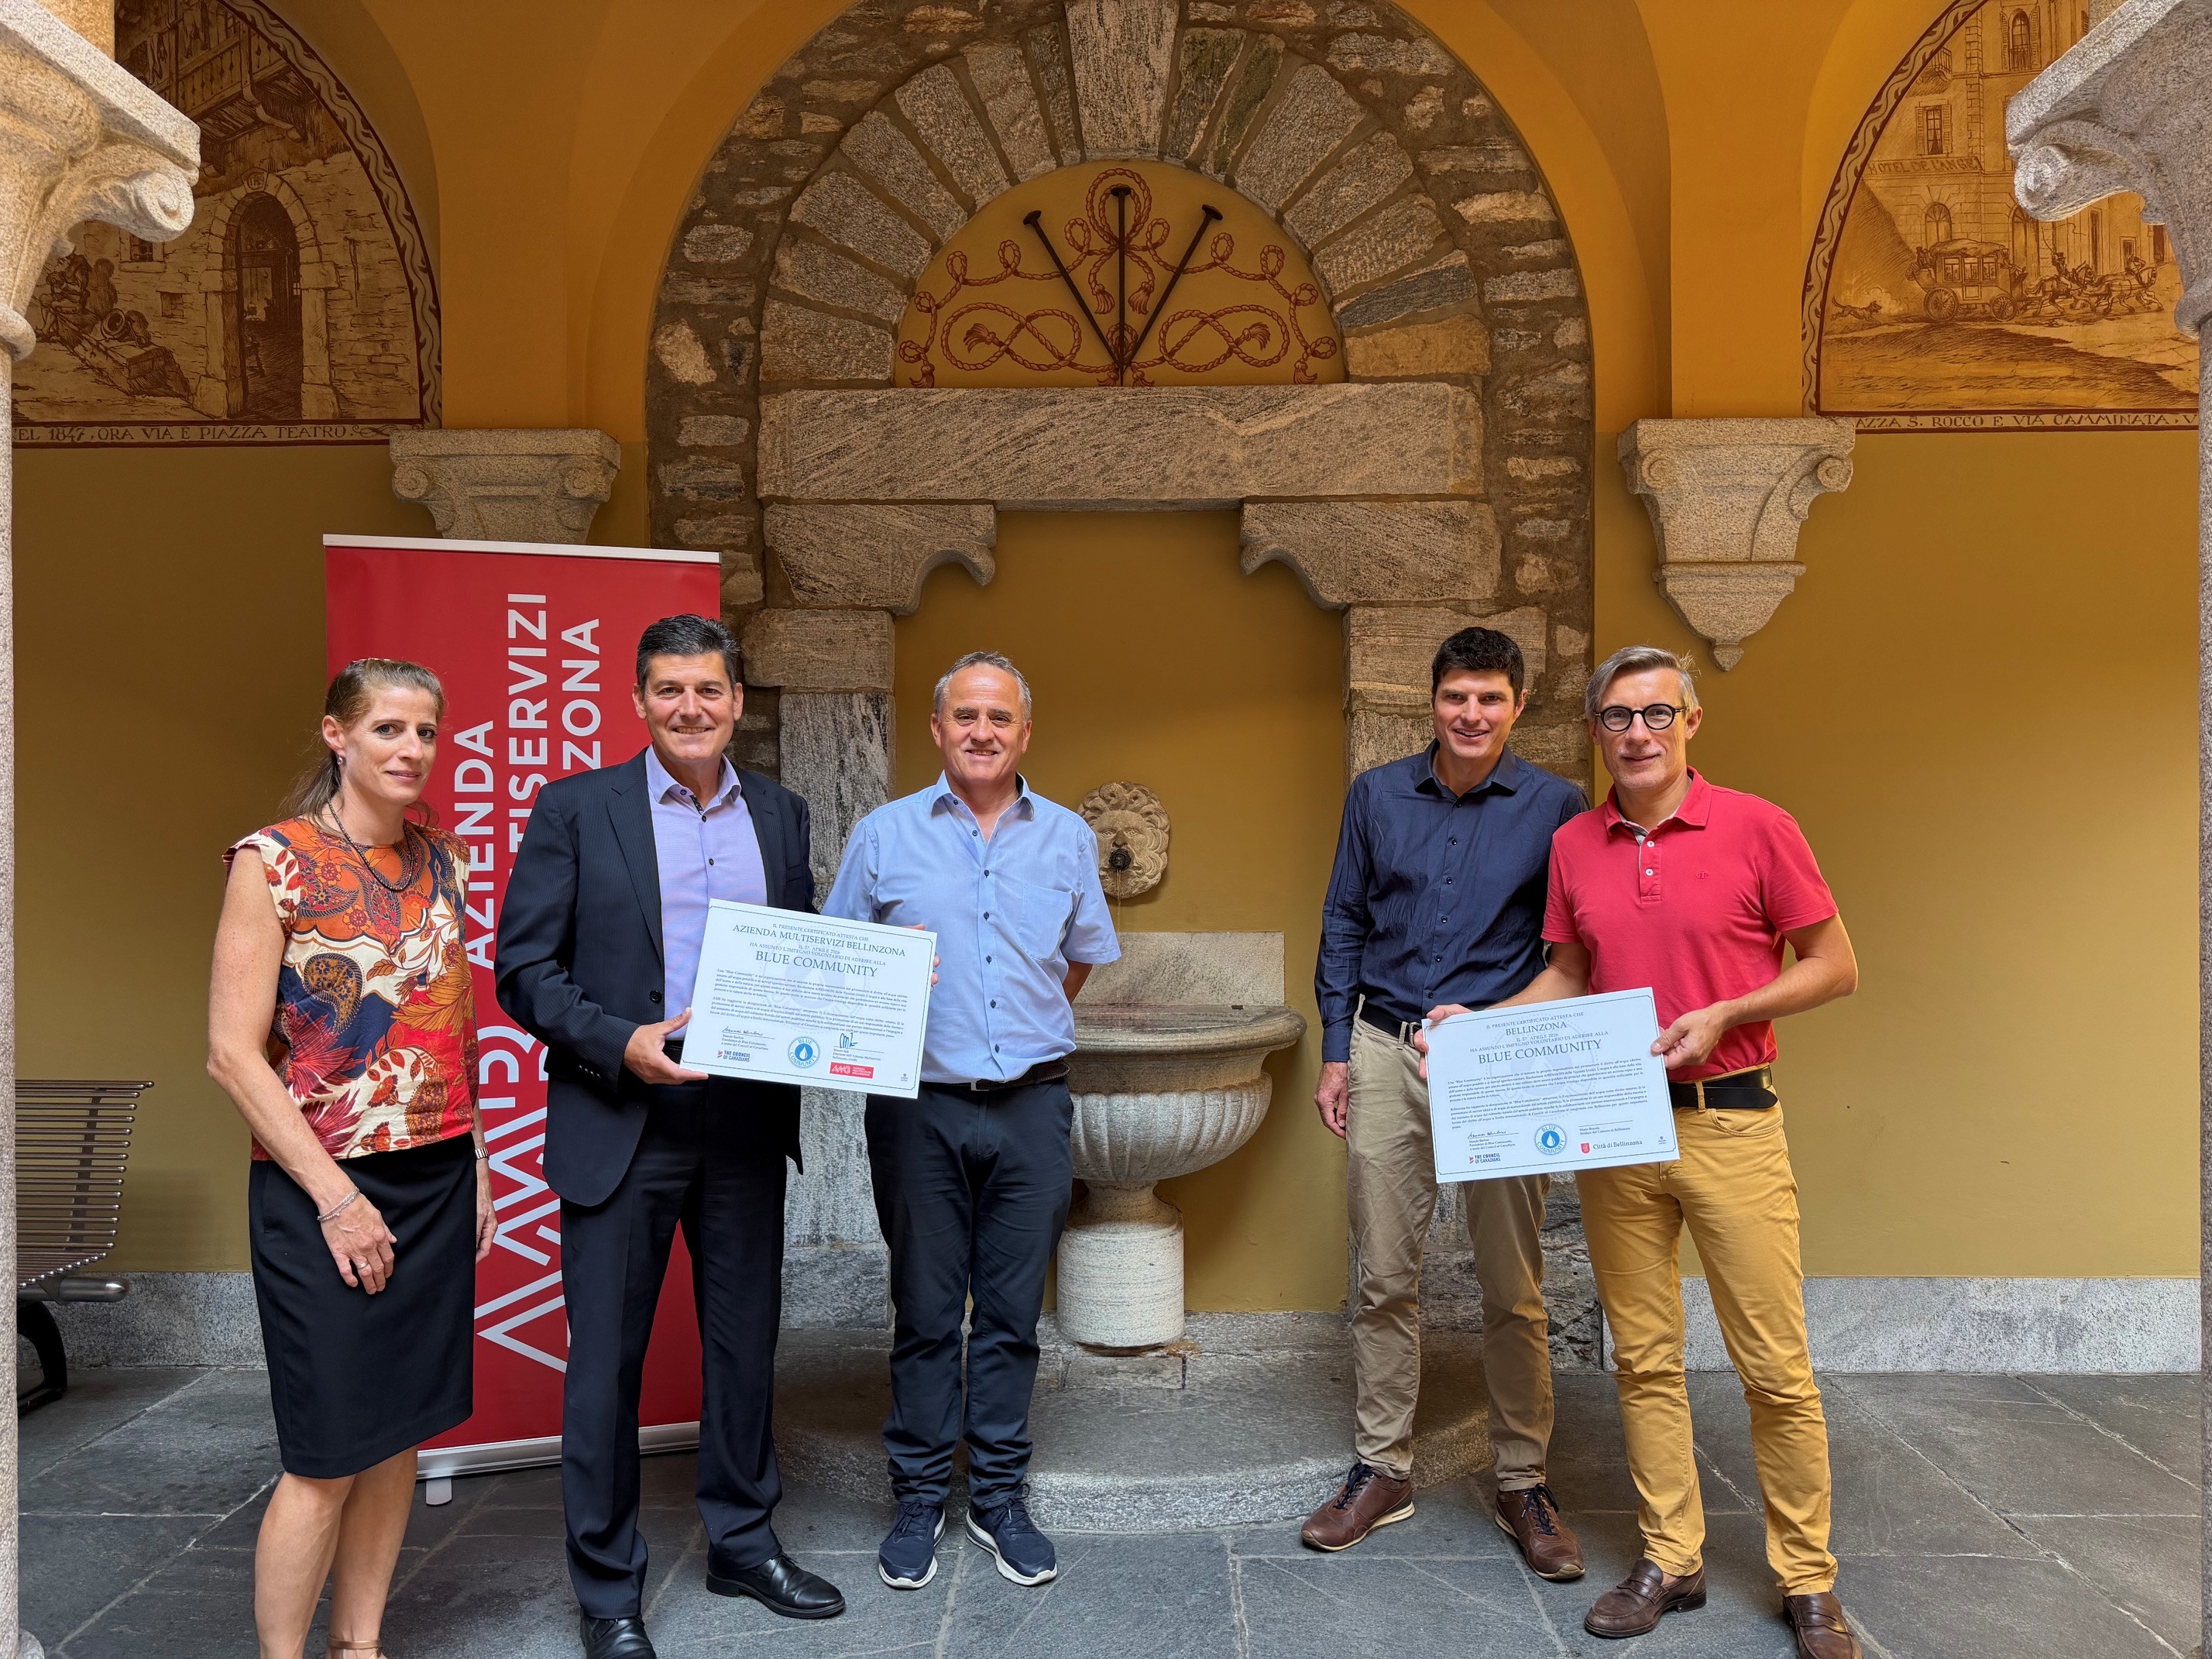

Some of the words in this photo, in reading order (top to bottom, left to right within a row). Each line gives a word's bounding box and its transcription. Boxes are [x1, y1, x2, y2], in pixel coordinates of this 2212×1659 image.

[1932, 415, 1984, 427] ROCCO
[1994, 415, 2004, 426] E
[2012, 414, 2045, 425] VIA
[98, 428, 134, 440] ORA
[142, 428, 173, 440] VIA
[181, 428, 191, 439] E
[199, 426, 267, 439] PIAZZA
[508, 593, 548, 877] TISERVIZI
[454, 720, 494, 970] AZIENDA
[778, 923, 802, 932] PRESENTE
[803, 927, 836, 936] CERTIFICATO
[733, 923, 777, 938] AZIENDA
[779, 930, 844, 947] MULTISERVIZI
[847, 940, 905, 957] BELLINZONA
[782, 946, 810, 955] L'IMPEGNO
[811, 950, 843, 960] VOLONTARIO
[755, 950, 789, 965] BLUE
[792, 955, 877, 977] COMMUNITY
[1516, 1016, 1549, 1025] CERTIFICATO
[1506, 1020, 1566, 1036] BELLINZONA
[1530, 1036, 1564, 1045] VOLONTARIO
[1479, 1050, 1511, 1064] BLUE
[1515, 1039, 1601, 1060] COMMUNITY
[1613, 1139, 1642, 1147] Bellinzona
